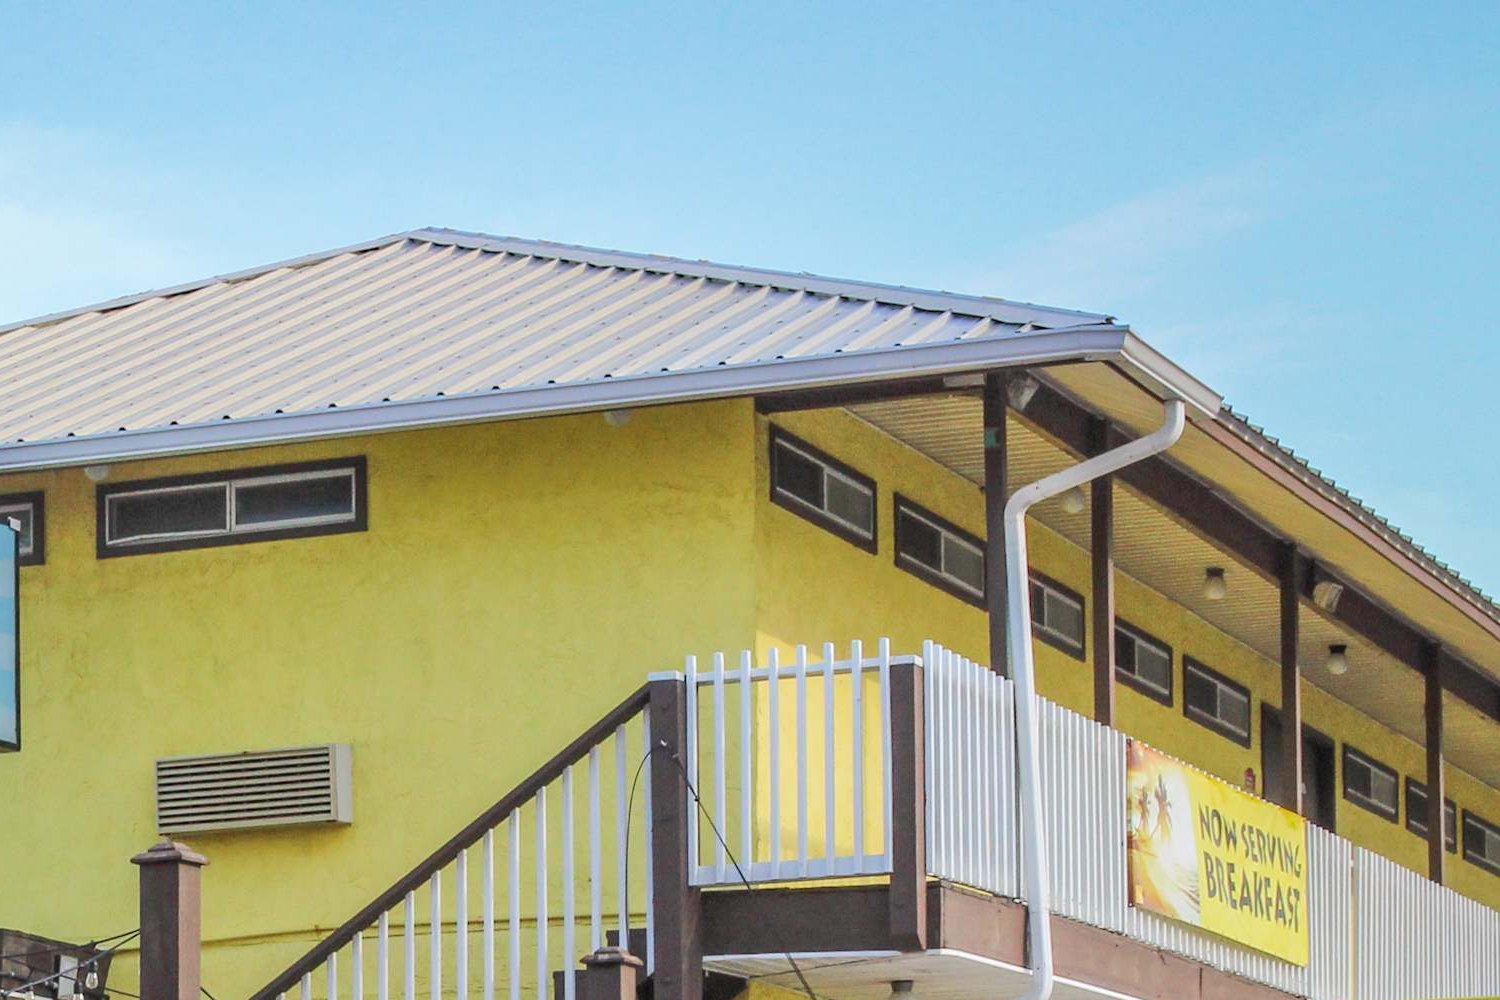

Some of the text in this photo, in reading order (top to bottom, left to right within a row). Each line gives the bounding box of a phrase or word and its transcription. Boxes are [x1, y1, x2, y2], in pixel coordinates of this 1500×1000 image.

[1199, 804, 1302, 877] NOW SERVING
[1203, 851, 1300, 933] BREAKFAST
